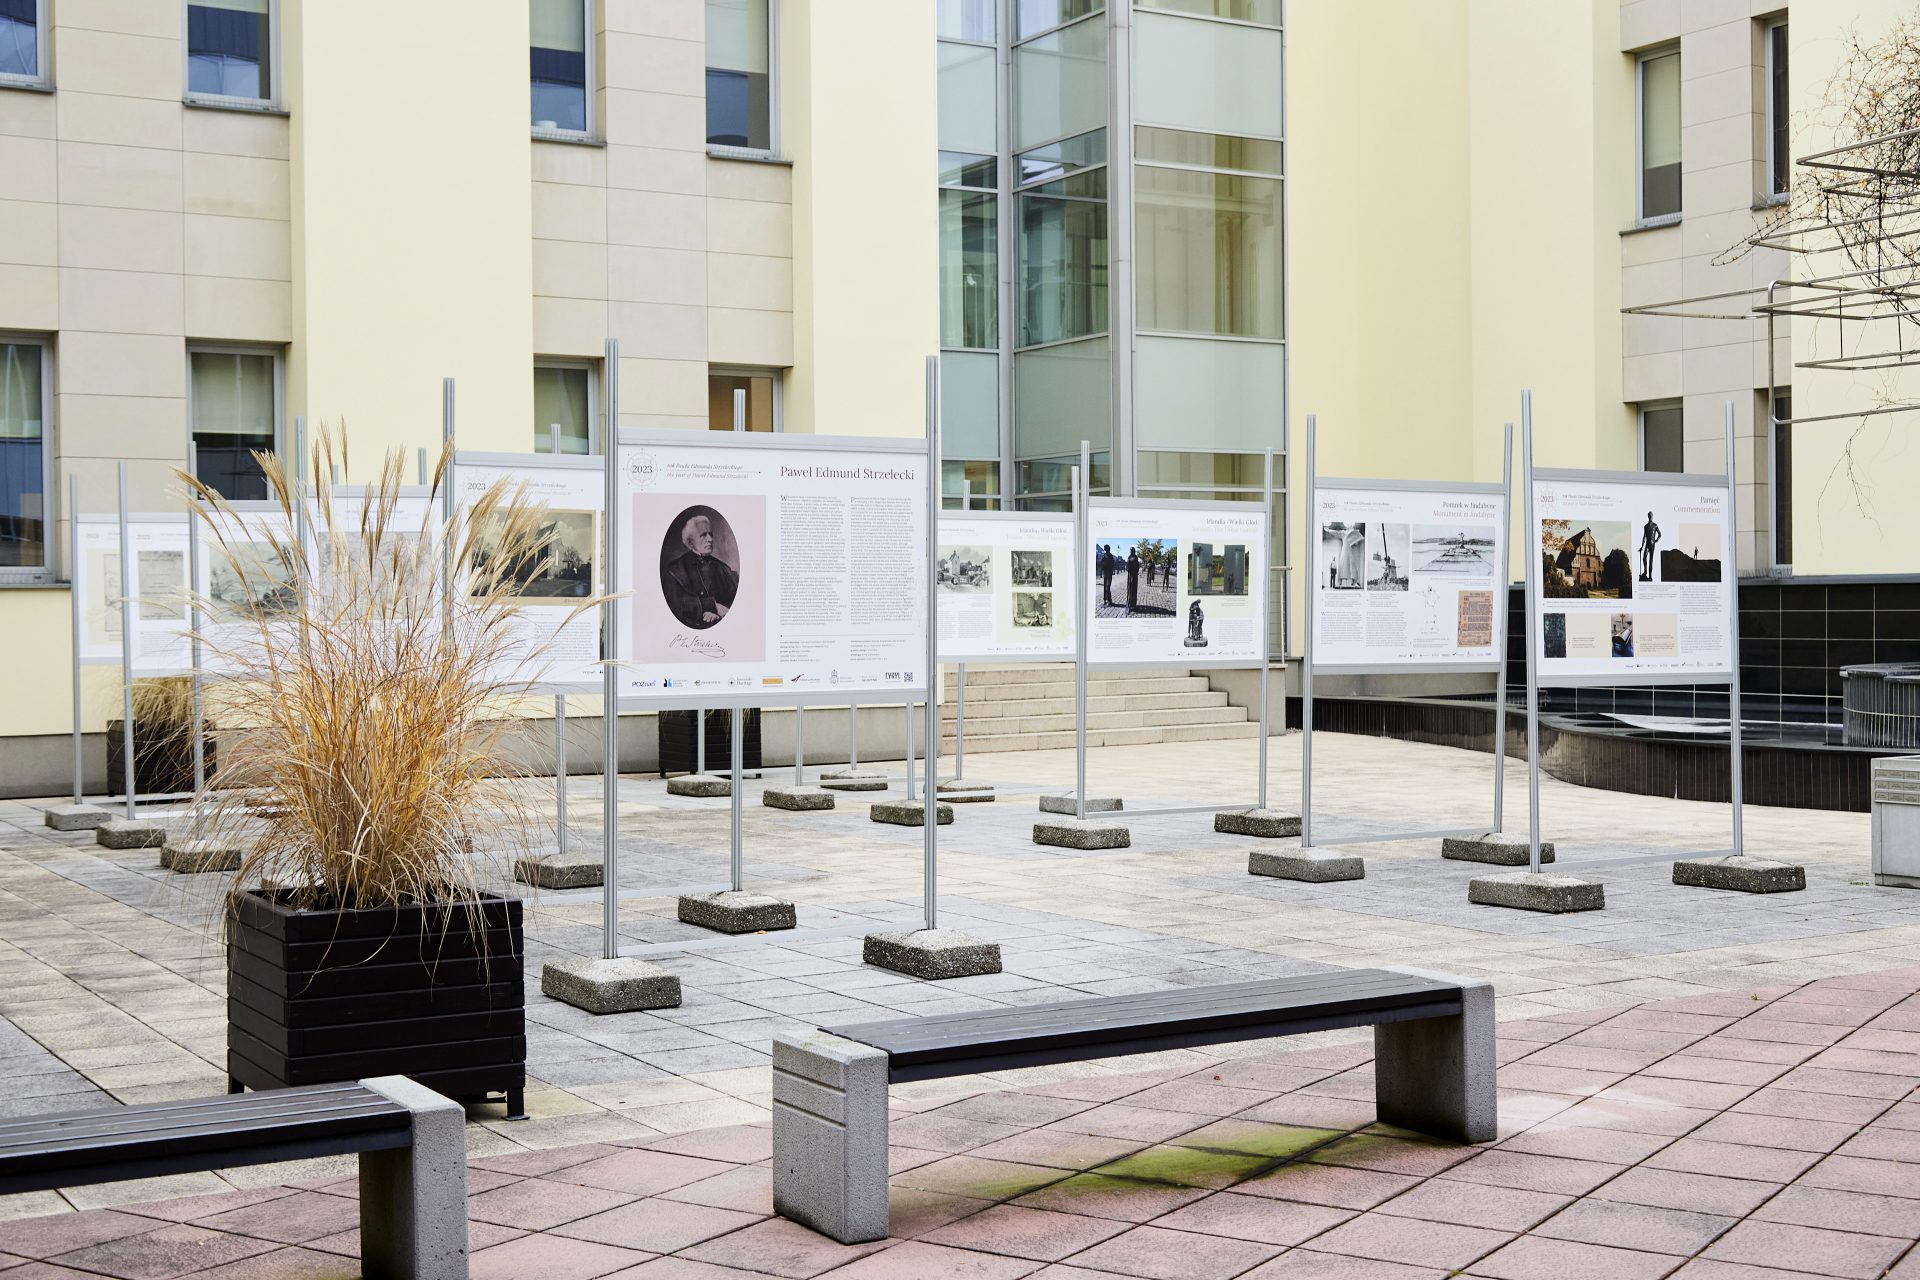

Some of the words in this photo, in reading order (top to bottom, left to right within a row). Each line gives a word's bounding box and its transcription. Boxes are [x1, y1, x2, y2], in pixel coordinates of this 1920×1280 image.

[632, 464, 653, 474] 2023
[780, 466, 812, 477] Paweł
[815, 467, 860, 479] Edmund
[863, 468, 915, 480] Strzelecki
[467, 482, 486, 491] 2023
